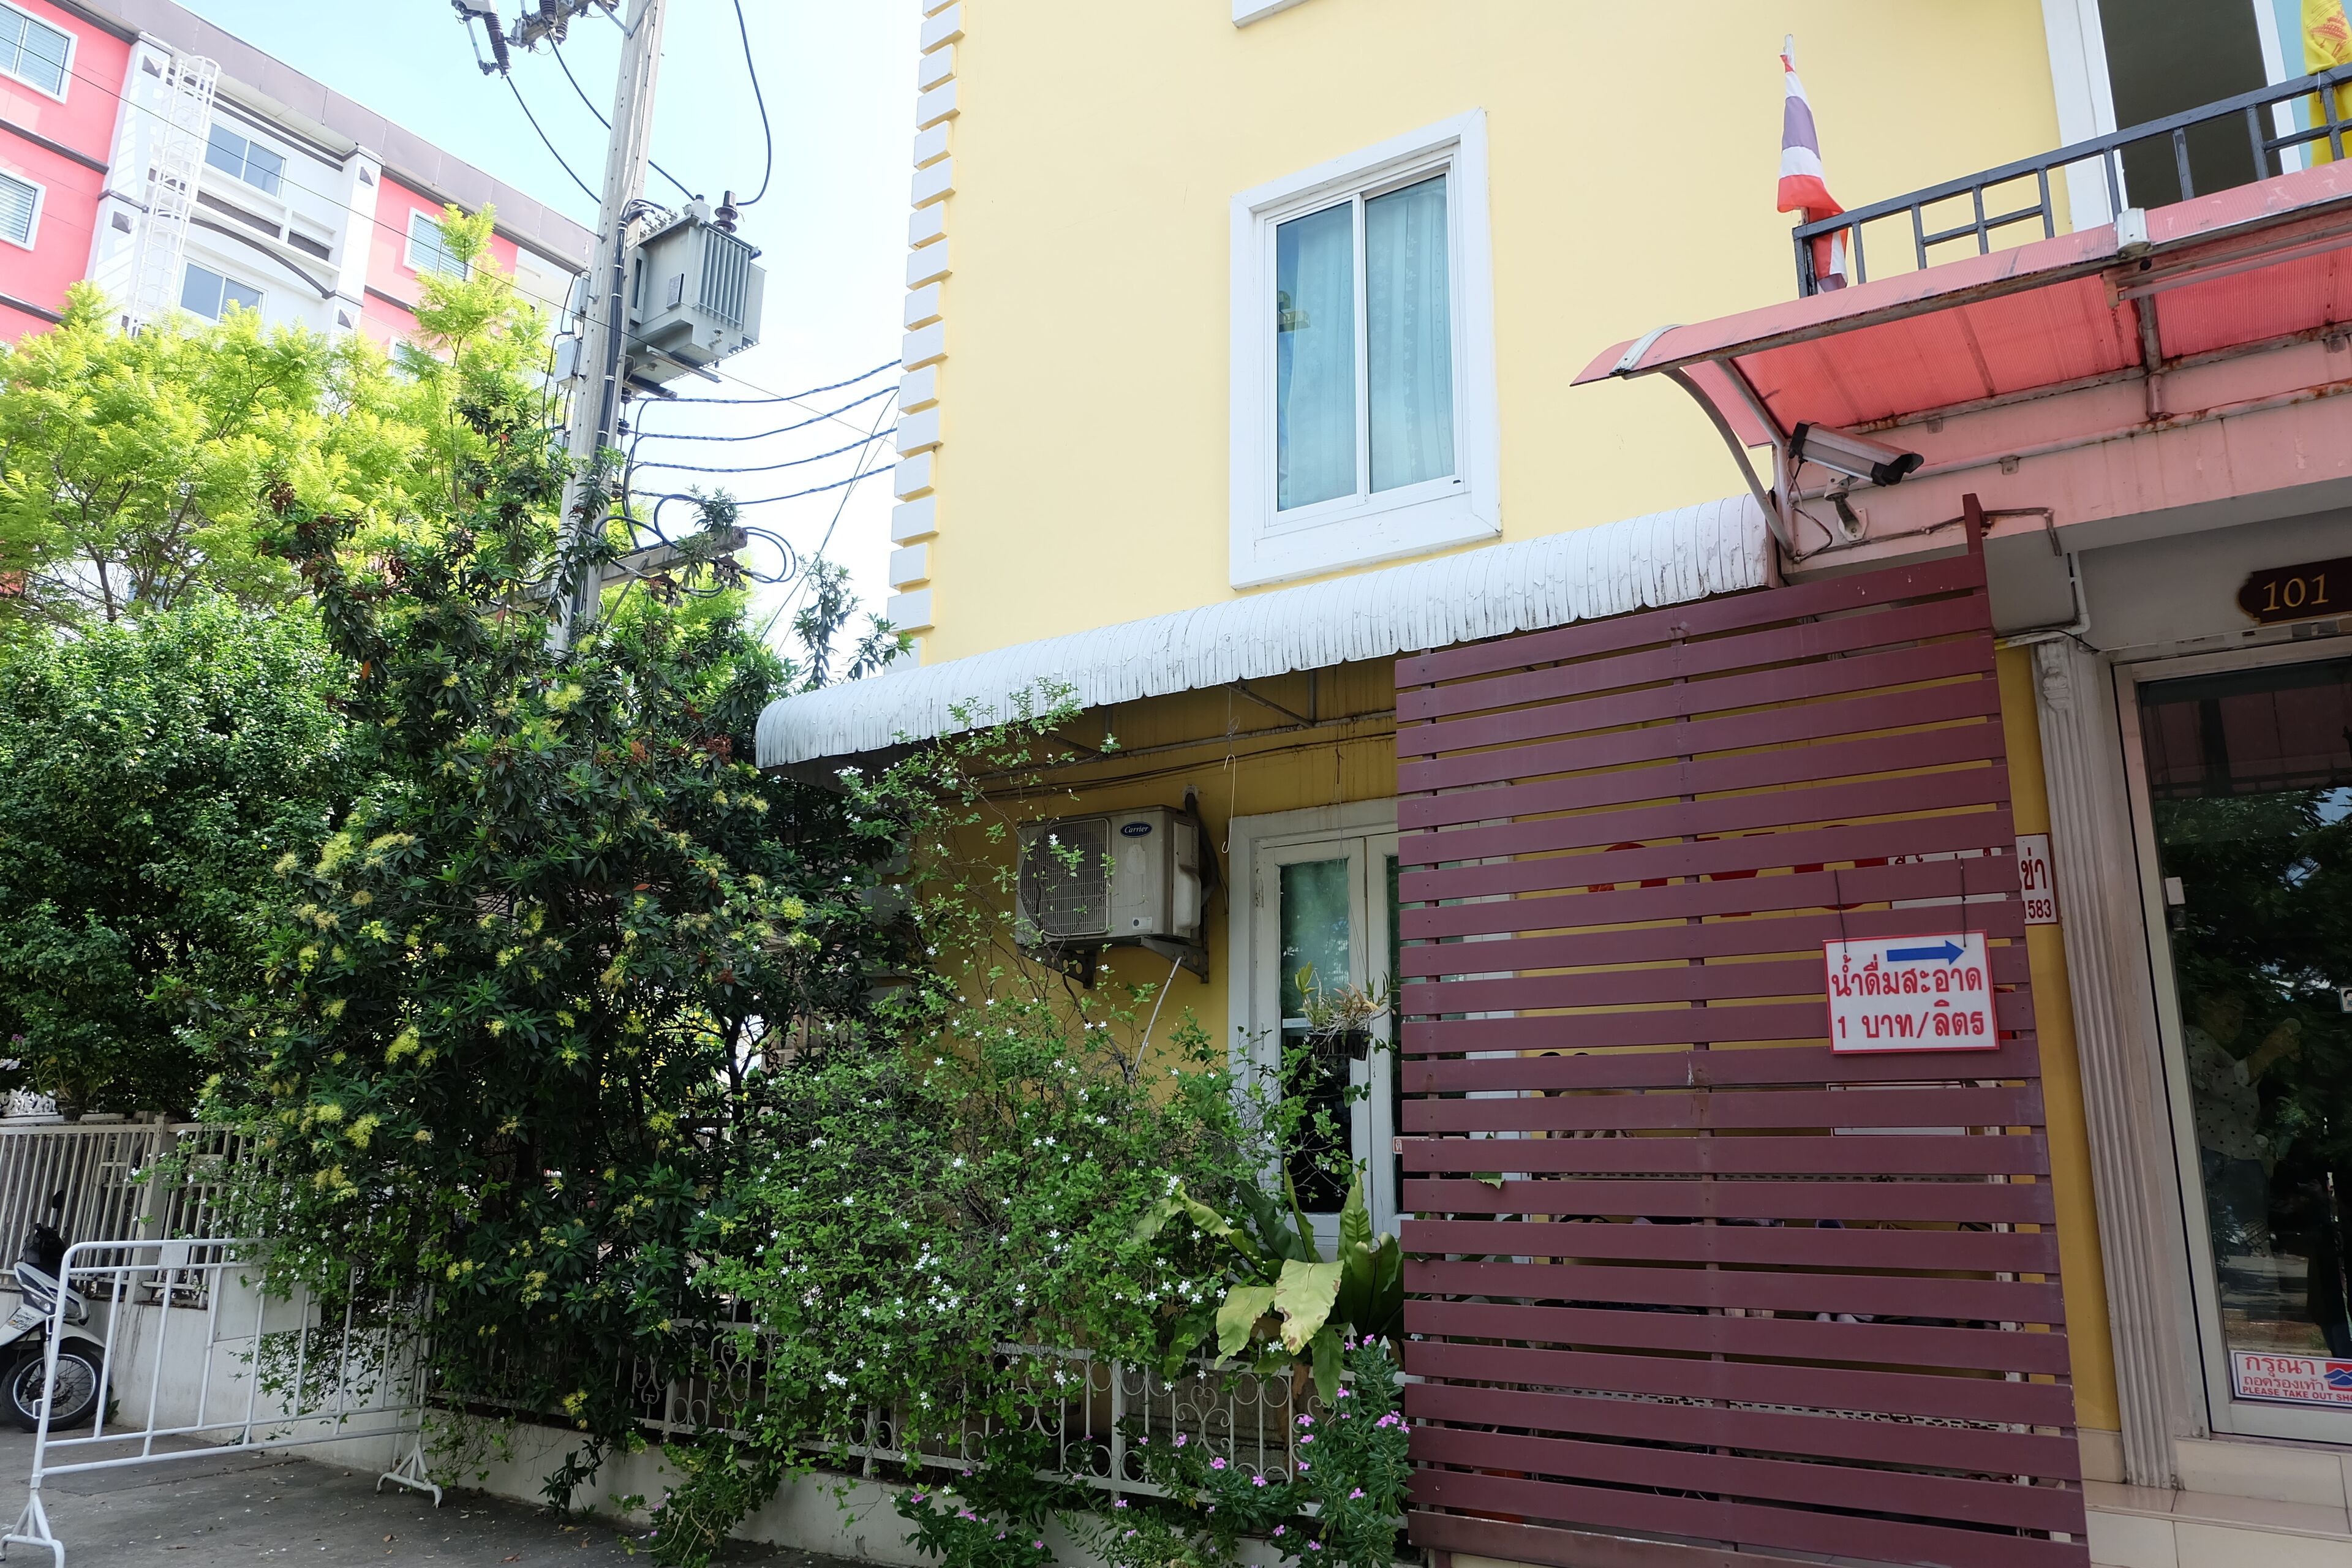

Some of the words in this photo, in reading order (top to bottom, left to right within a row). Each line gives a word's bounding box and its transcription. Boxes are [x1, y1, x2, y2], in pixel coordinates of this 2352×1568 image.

[2262, 573, 2329, 612] 101
[2022, 898, 2052, 919] 1583
[1831, 953, 1983, 997] น้ำดื่มสะอาด
[1838, 1015, 1847, 1039] 1
[2245, 1356, 2315, 1378] กรุณา
[2242, 1385, 2280, 1396] PLEASE
[2283, 1389, 2309, 1398] TAKE
[2312, 1392, 2333, 1400] OUT
